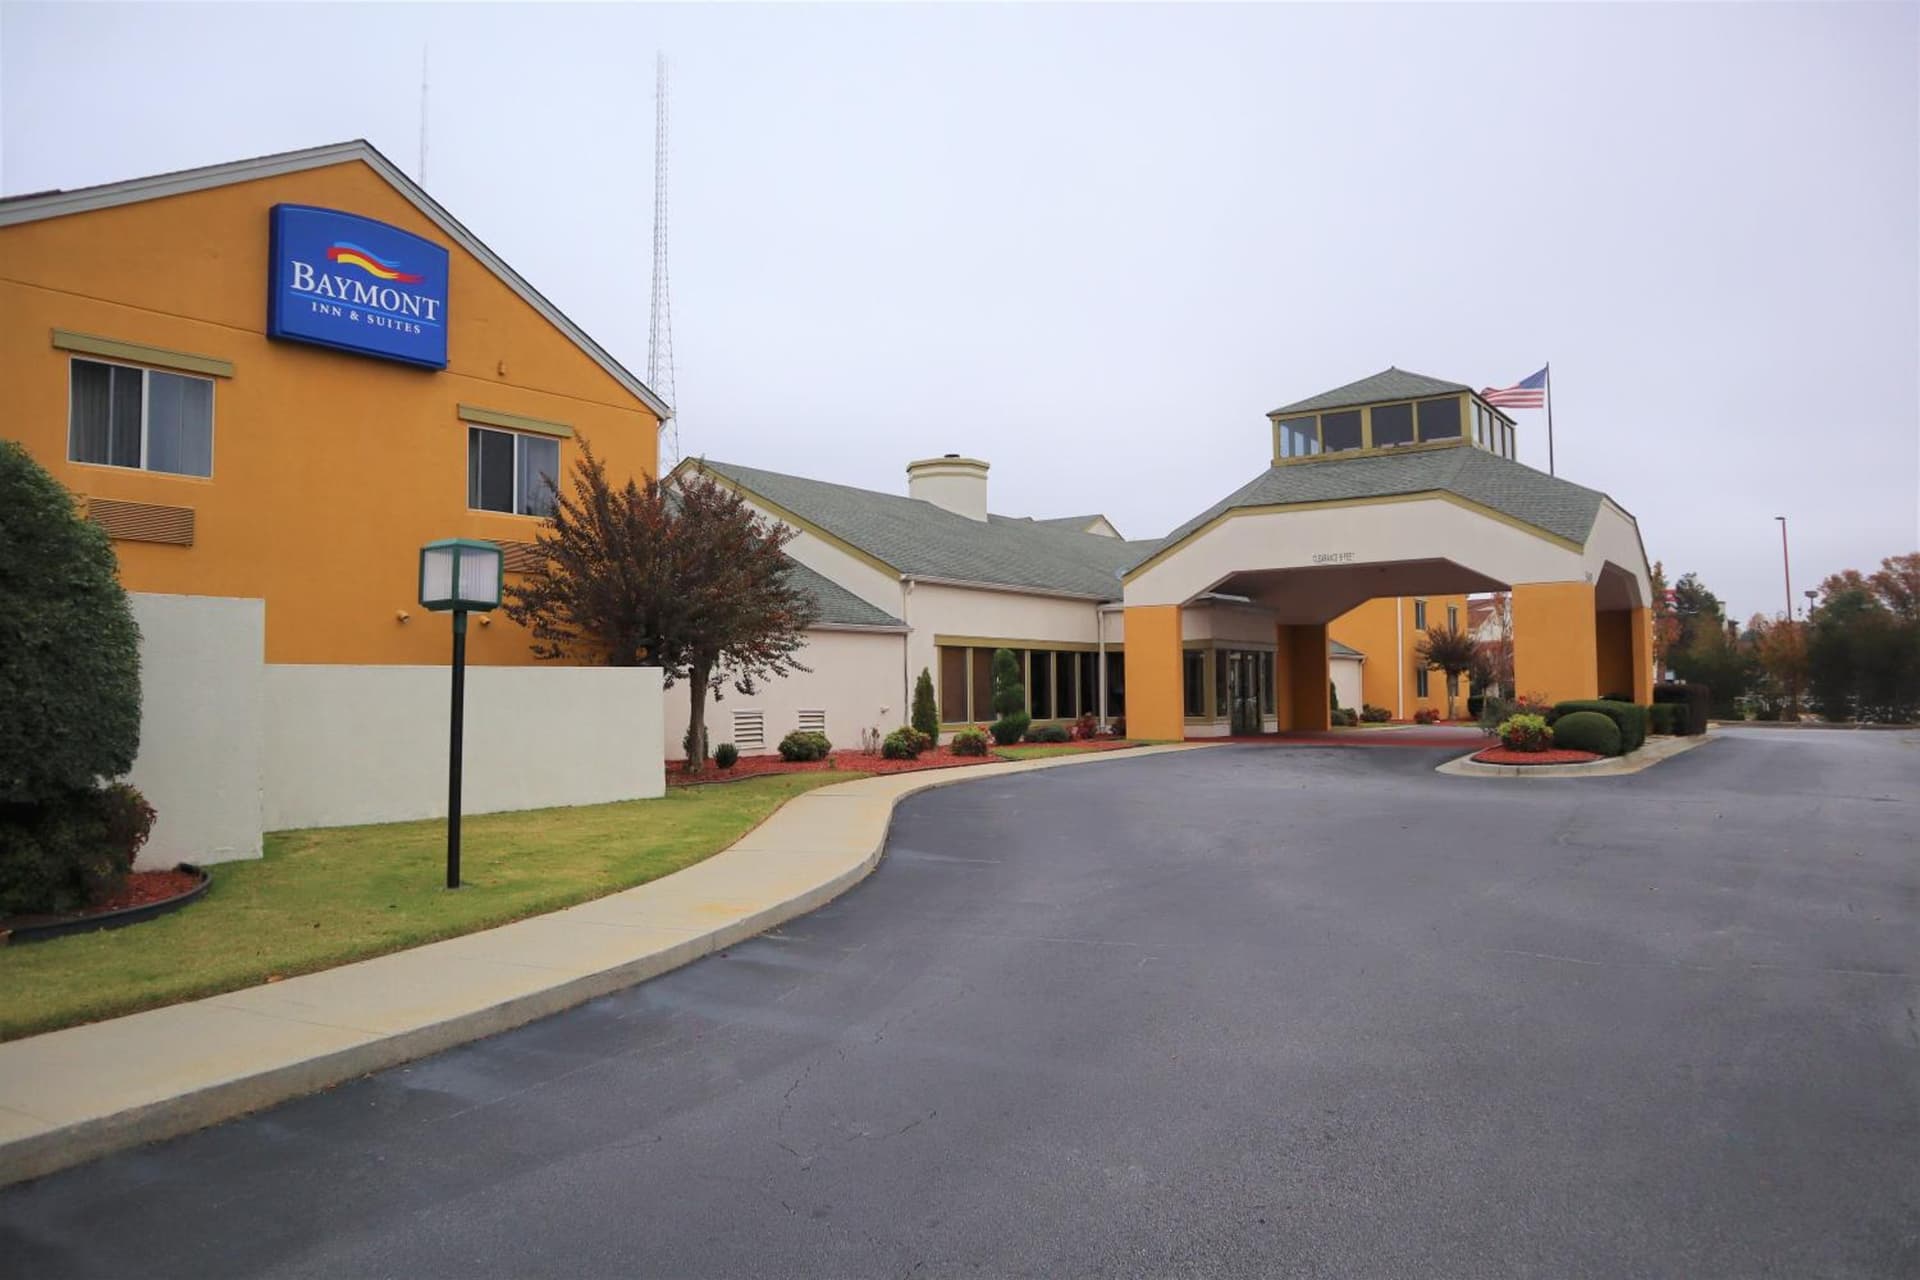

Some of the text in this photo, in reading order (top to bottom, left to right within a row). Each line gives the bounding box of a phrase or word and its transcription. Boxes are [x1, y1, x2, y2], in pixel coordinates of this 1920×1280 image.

[290, 260, 440, 321] BAYMONT
[311, 302, 421, 334] INN & SUITES
